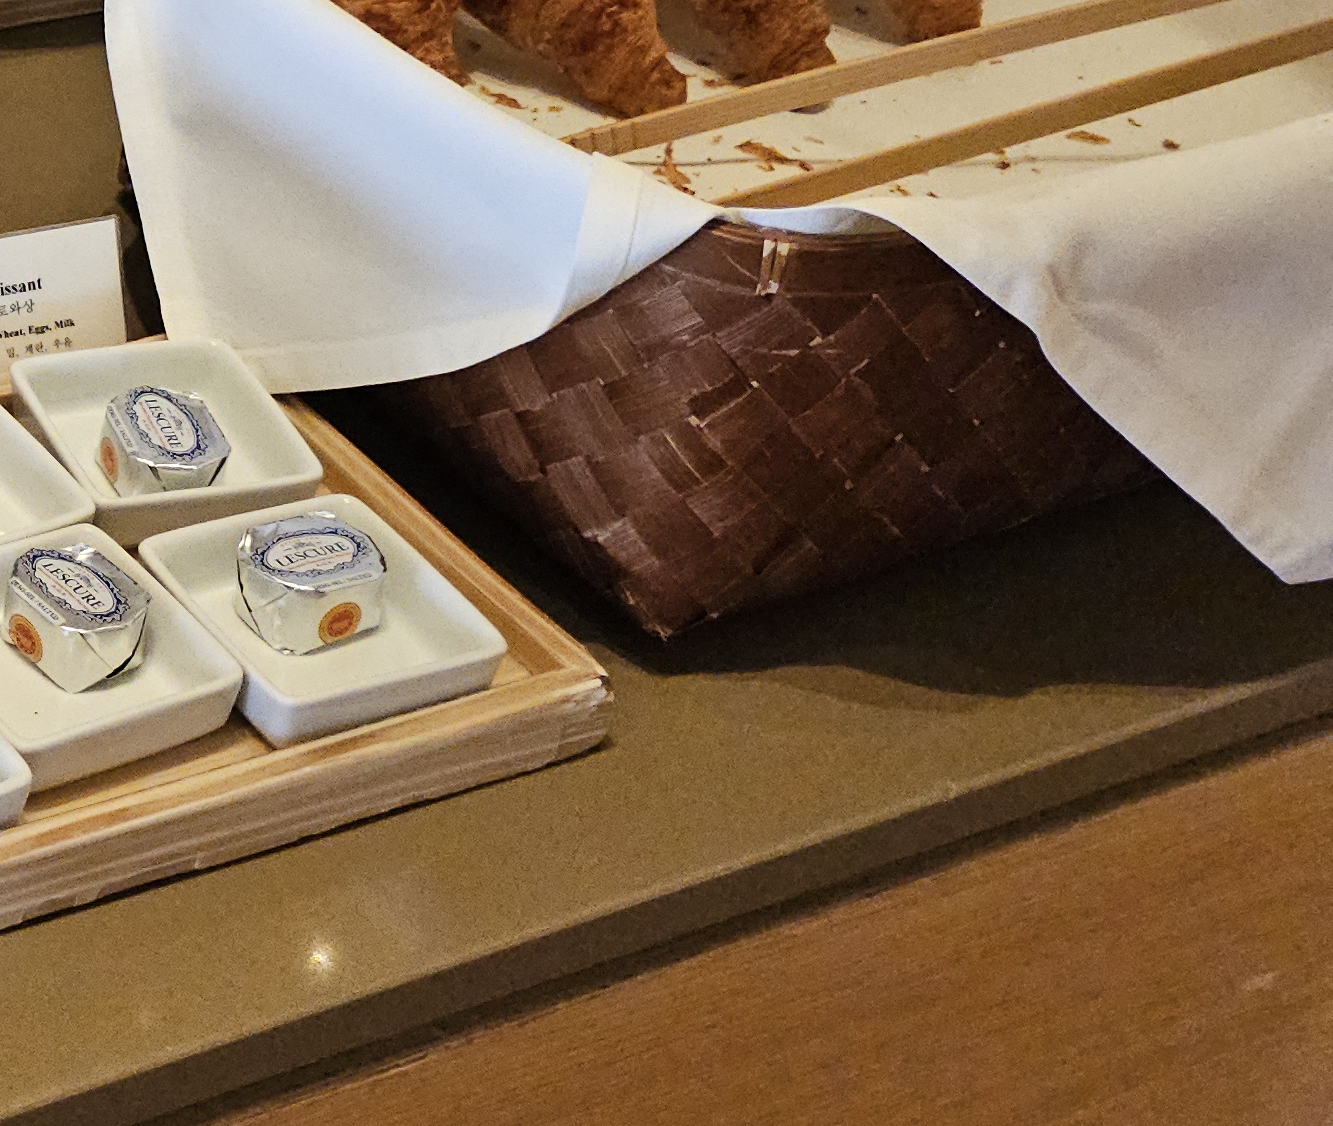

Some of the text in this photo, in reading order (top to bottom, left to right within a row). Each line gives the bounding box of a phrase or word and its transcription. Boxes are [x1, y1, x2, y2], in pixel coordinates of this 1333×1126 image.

[54, 318, 75, 329] Milk
[144, 398, 183, 449] LESCURE
[275, 542, 349, 567] LESCURE
[42, 562, 105, 610] LESCURE
